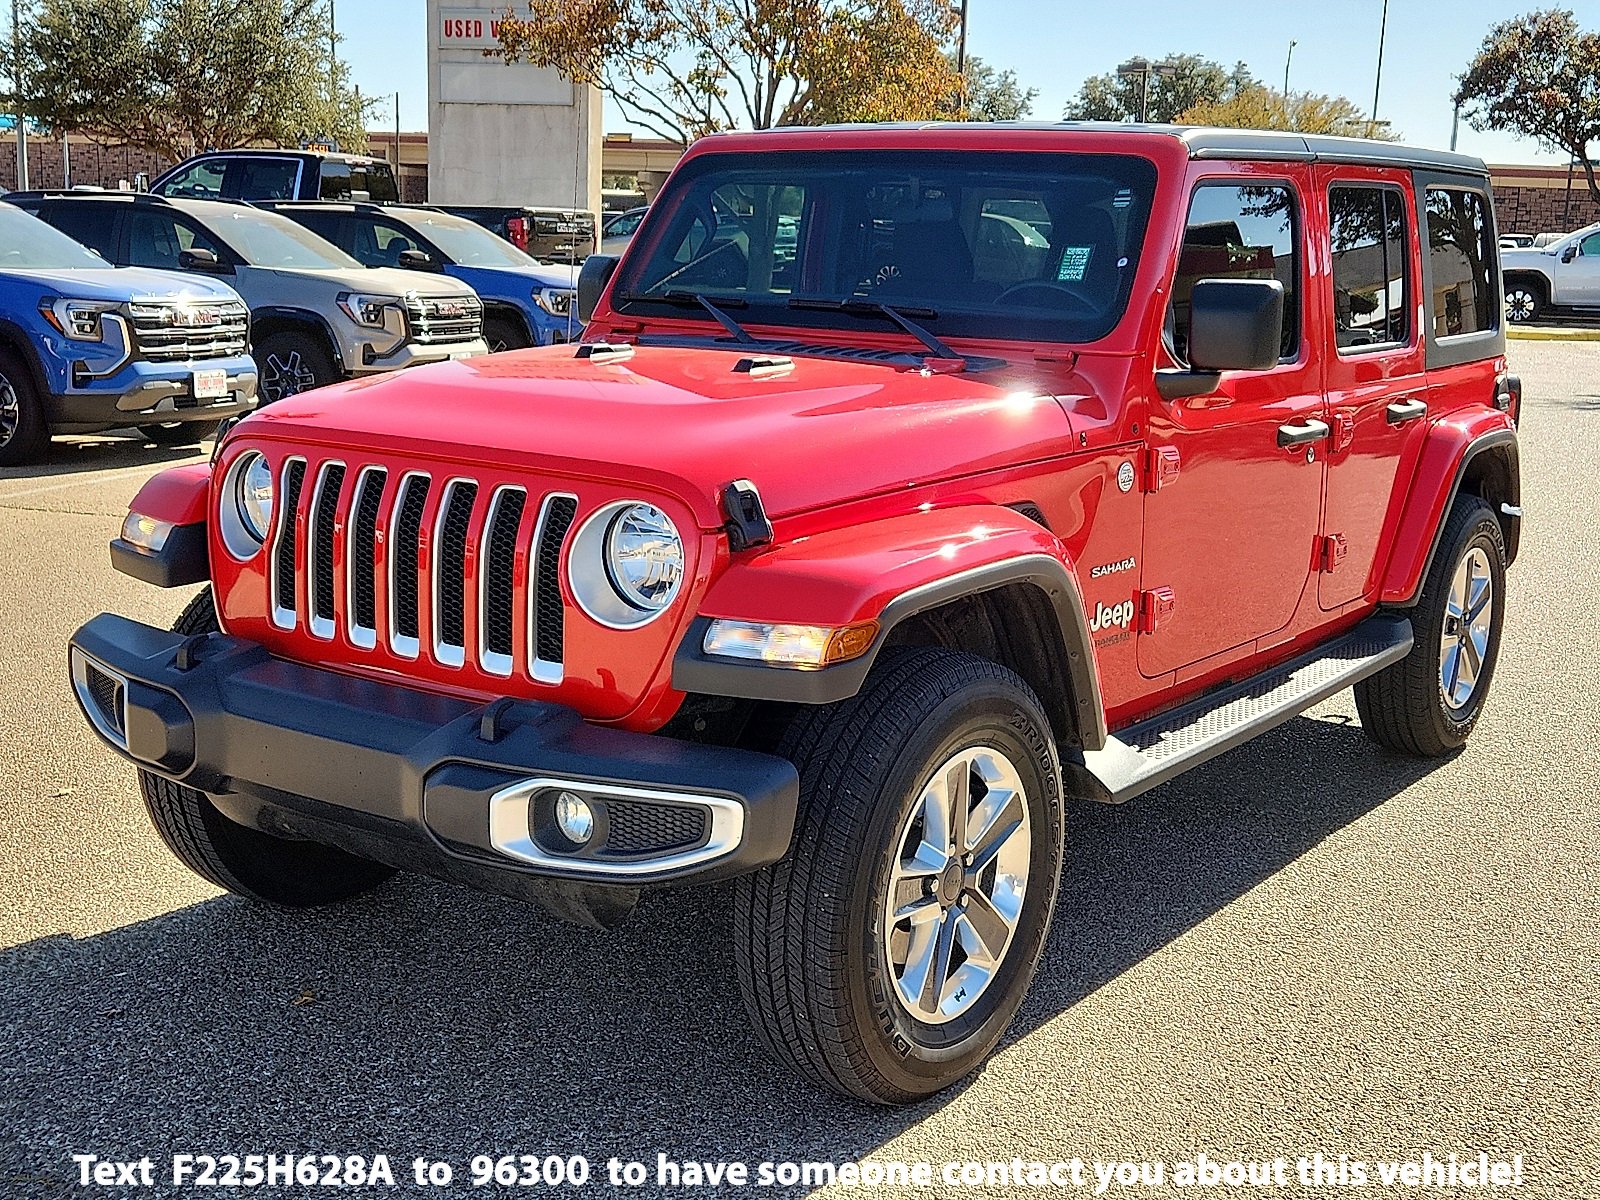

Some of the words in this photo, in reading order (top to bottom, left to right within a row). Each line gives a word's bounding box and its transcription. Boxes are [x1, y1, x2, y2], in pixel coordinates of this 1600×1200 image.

[444, 19, 482, 38] USED
[1090, 557, 1136, 579] SAHARA
[1090, 600, 1134, 632] Jeep
